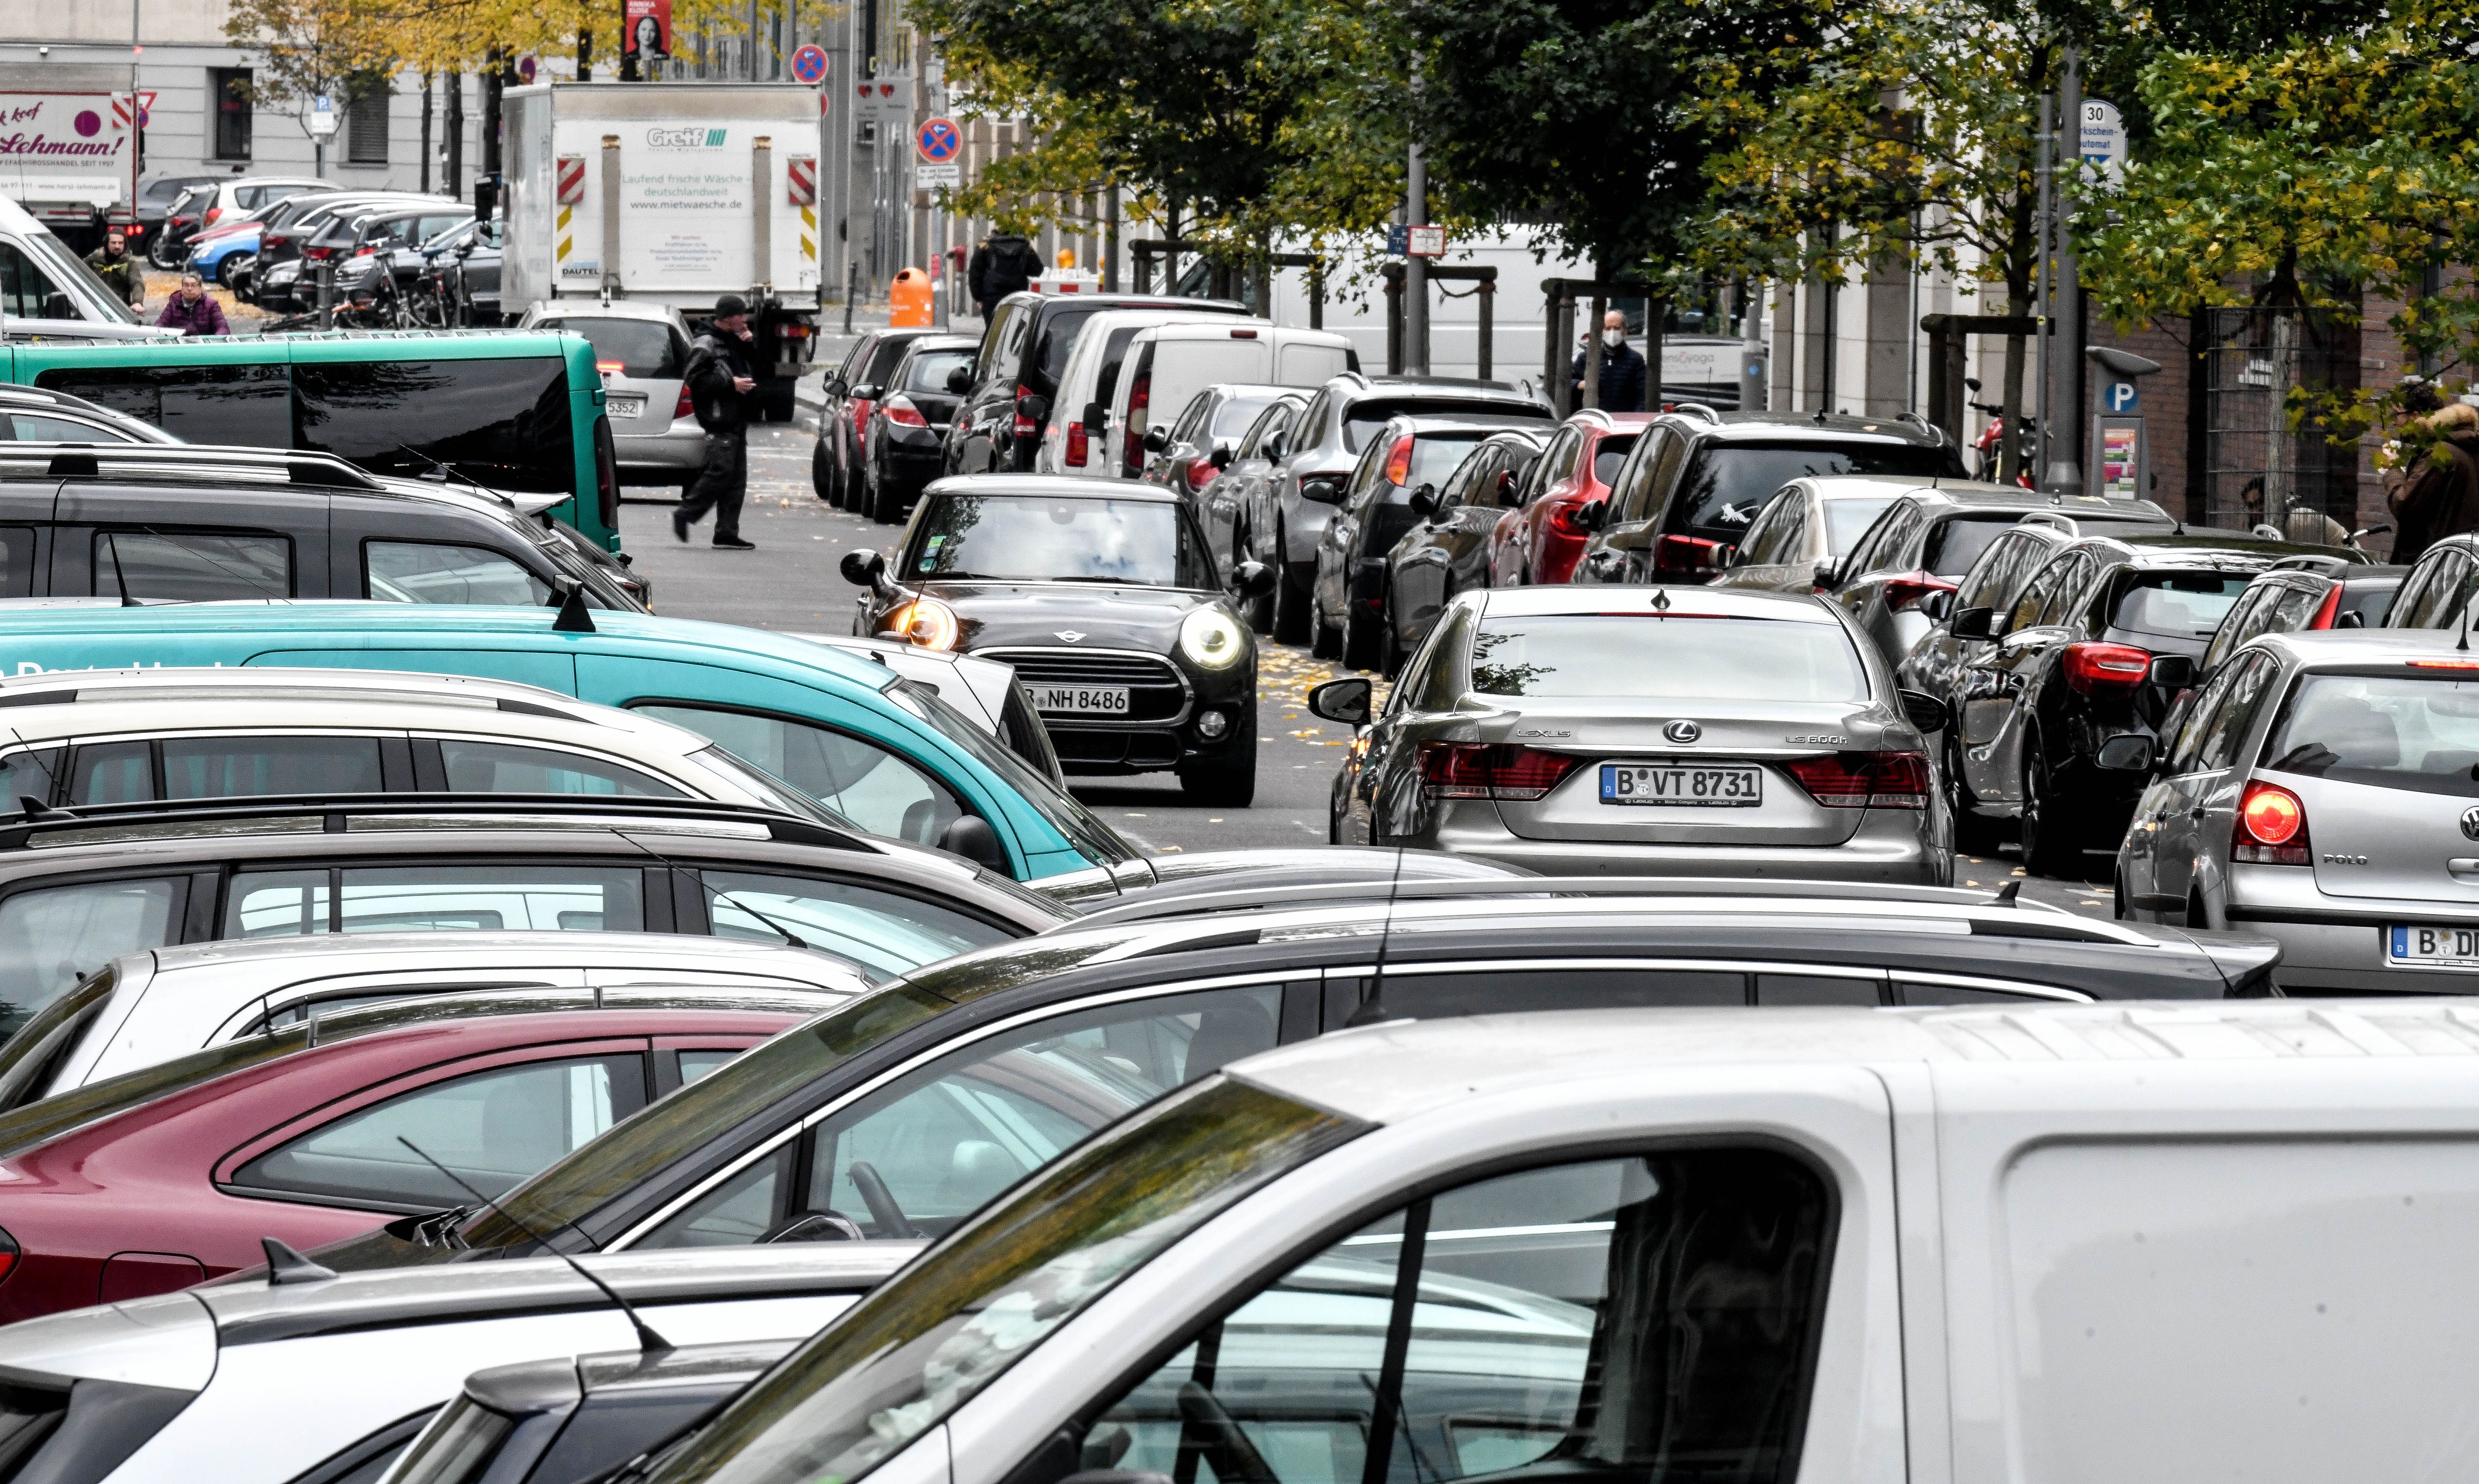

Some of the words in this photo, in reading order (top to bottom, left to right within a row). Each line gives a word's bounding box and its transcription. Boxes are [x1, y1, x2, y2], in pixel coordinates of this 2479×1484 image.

[2087, 107, 2103, 121] 30
[647, 128, 704, 146] Greif
[2080, 127, 2118, 136] rkschein-
[0, 133, 124, 155] Lehmann!
[623, 174, 664, 183] Laufend
[668, 174, 701, 183] frische
[704, 174, 743, 183] Wäsche
[644, 188, 728, 196] deutschlandweit
[630, 201, 742, 209] www.mietwaesche.de
[2115, 383, 2134, 411] P
[609, 402, 635, 413] 5352
[1048, 690, 1073, 708] NH
[1078, 691, 1125, 709] 8486
[1808, 735, 1848, 744] 600h
[1618, 770, 1633, 794] B
[1653, 771, 1686, 796] VT
[1692, 771, 1756, 797] 8731
[2323, 854, 2368, 865] POLO
[2420, 930, 2436, 954] B
[2455, 931, 2479, 957] D
